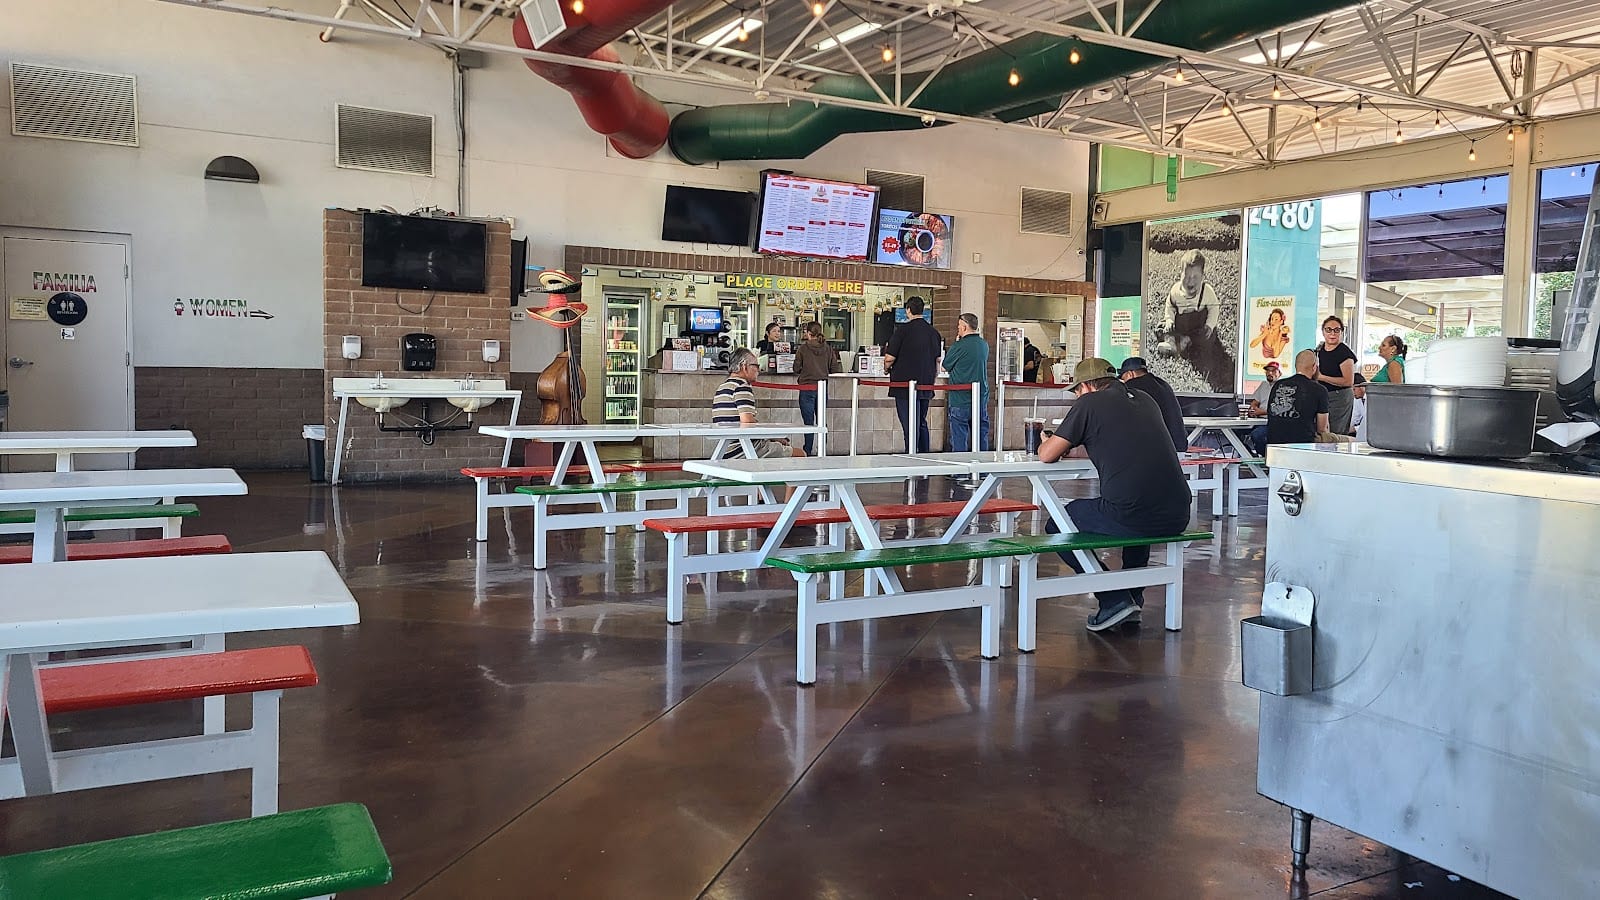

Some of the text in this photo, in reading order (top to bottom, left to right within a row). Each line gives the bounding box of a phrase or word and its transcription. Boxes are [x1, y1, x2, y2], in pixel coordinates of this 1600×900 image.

[33, 272, 97, 293] FAMILIA
[726, 275, 862, 294] PLACE ORDER HERE
[189, 298, 248, 318] WOMEN
